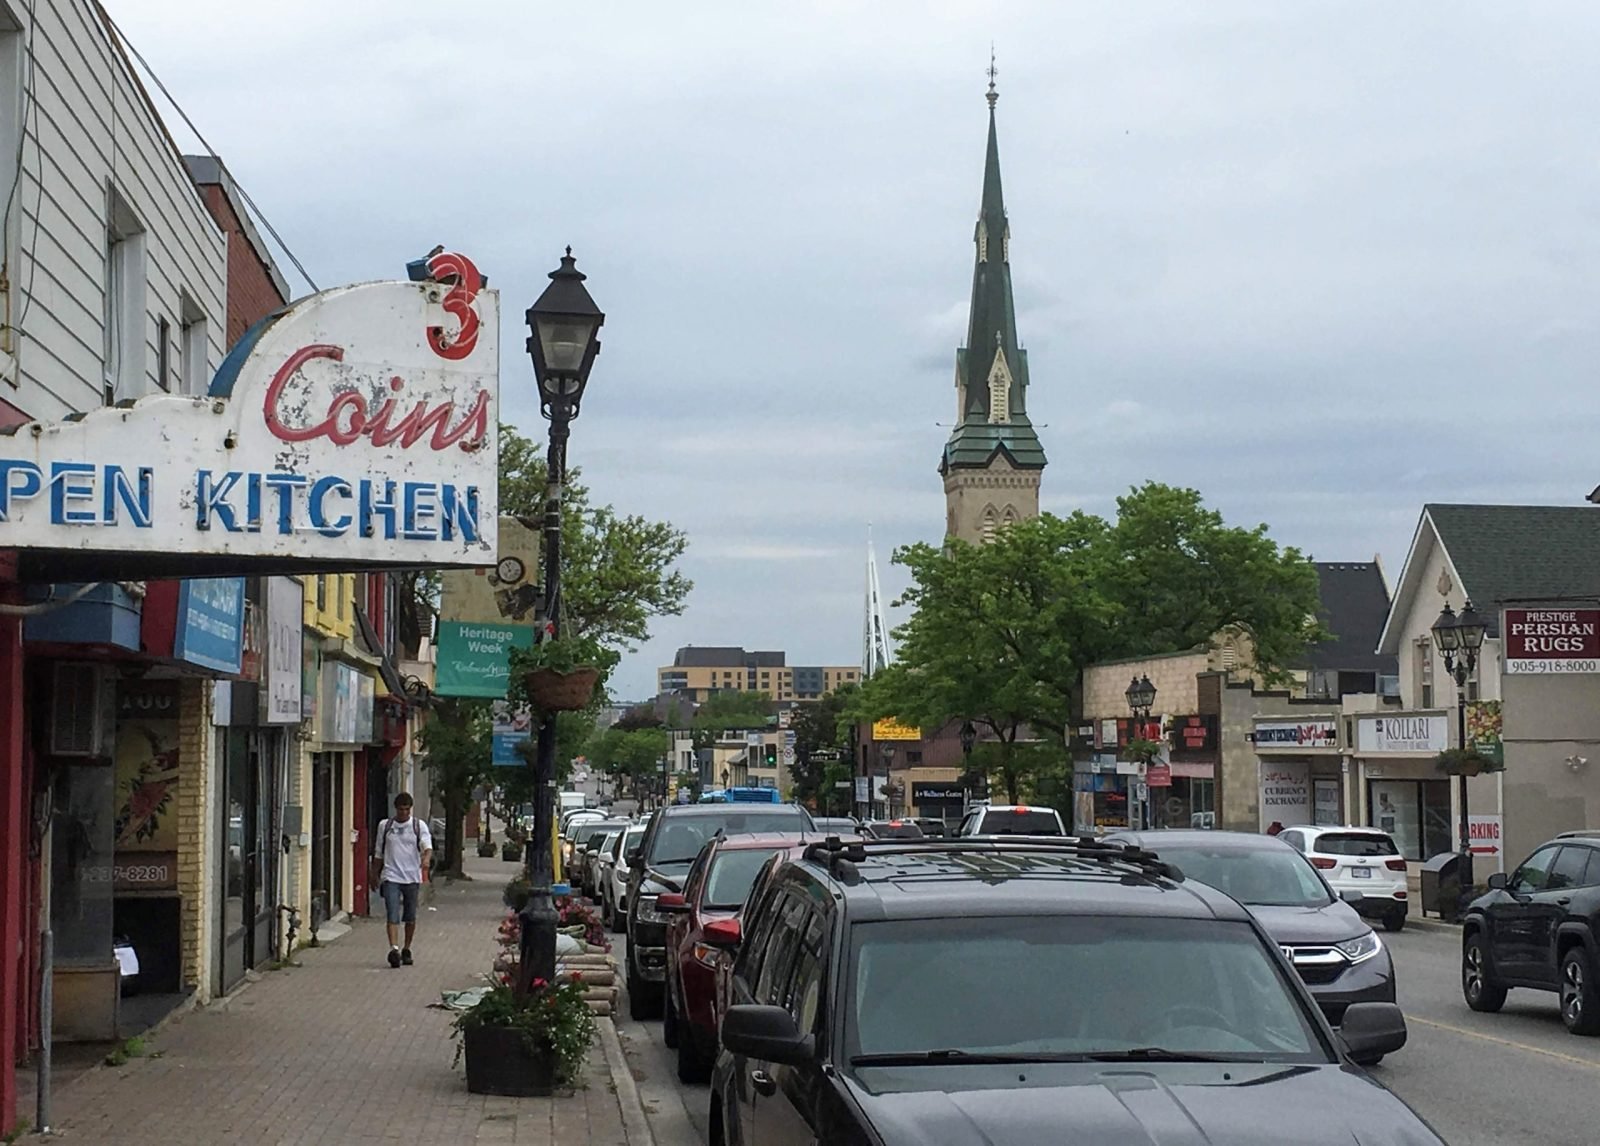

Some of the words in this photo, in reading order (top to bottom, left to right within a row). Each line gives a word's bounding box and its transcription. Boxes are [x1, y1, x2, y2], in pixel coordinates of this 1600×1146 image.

[425, 251, 481, 360] 3
[262, 343, 488, 452] Coins
[197, 468, 479, 542] KITCHEN
[1526, 612, 1577, 622] PRESTIGE
[459, 626, 514, 643] Heritage
[1511, 623, 1594, 636] PERSIAN
[467, 641, 503, 655] Week
[1524, 637, 1585, 652] RUGS
[1512, 661, 1596, 673] 905-918-8000
[1385, 718, 1430, 739] KOLLARI
[1264, 787, 1307, 795] CURRENCY
[1264, 797, 1308, 805] EXCHANGE
[1459, 822, 1499, 839] RKING
